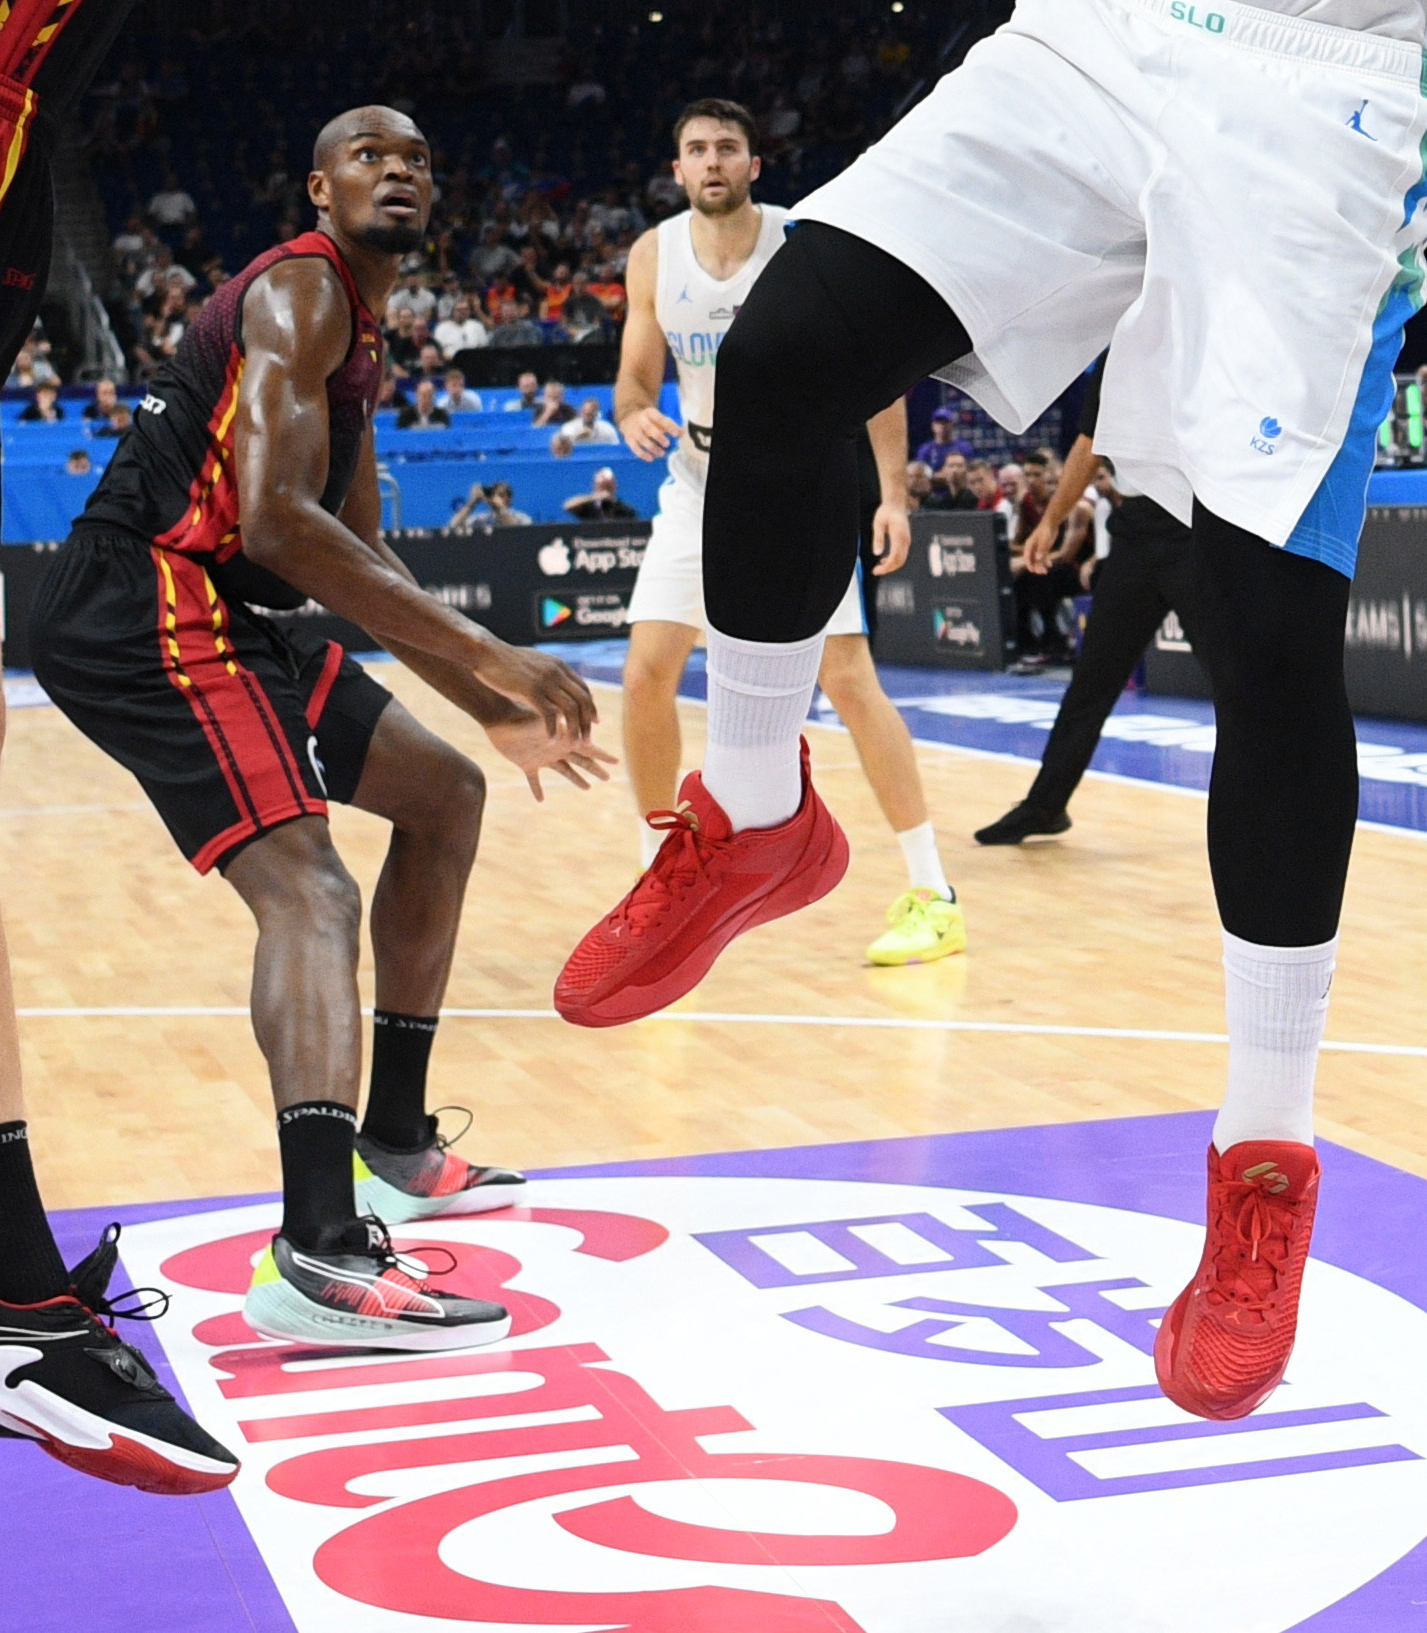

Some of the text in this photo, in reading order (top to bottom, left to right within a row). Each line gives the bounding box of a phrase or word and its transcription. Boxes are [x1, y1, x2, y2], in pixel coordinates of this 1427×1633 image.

[1170, 0, 1226, 35] SLO
[1250, 436, 1276, 456] KZS
[576, 550, 616, 573] App
